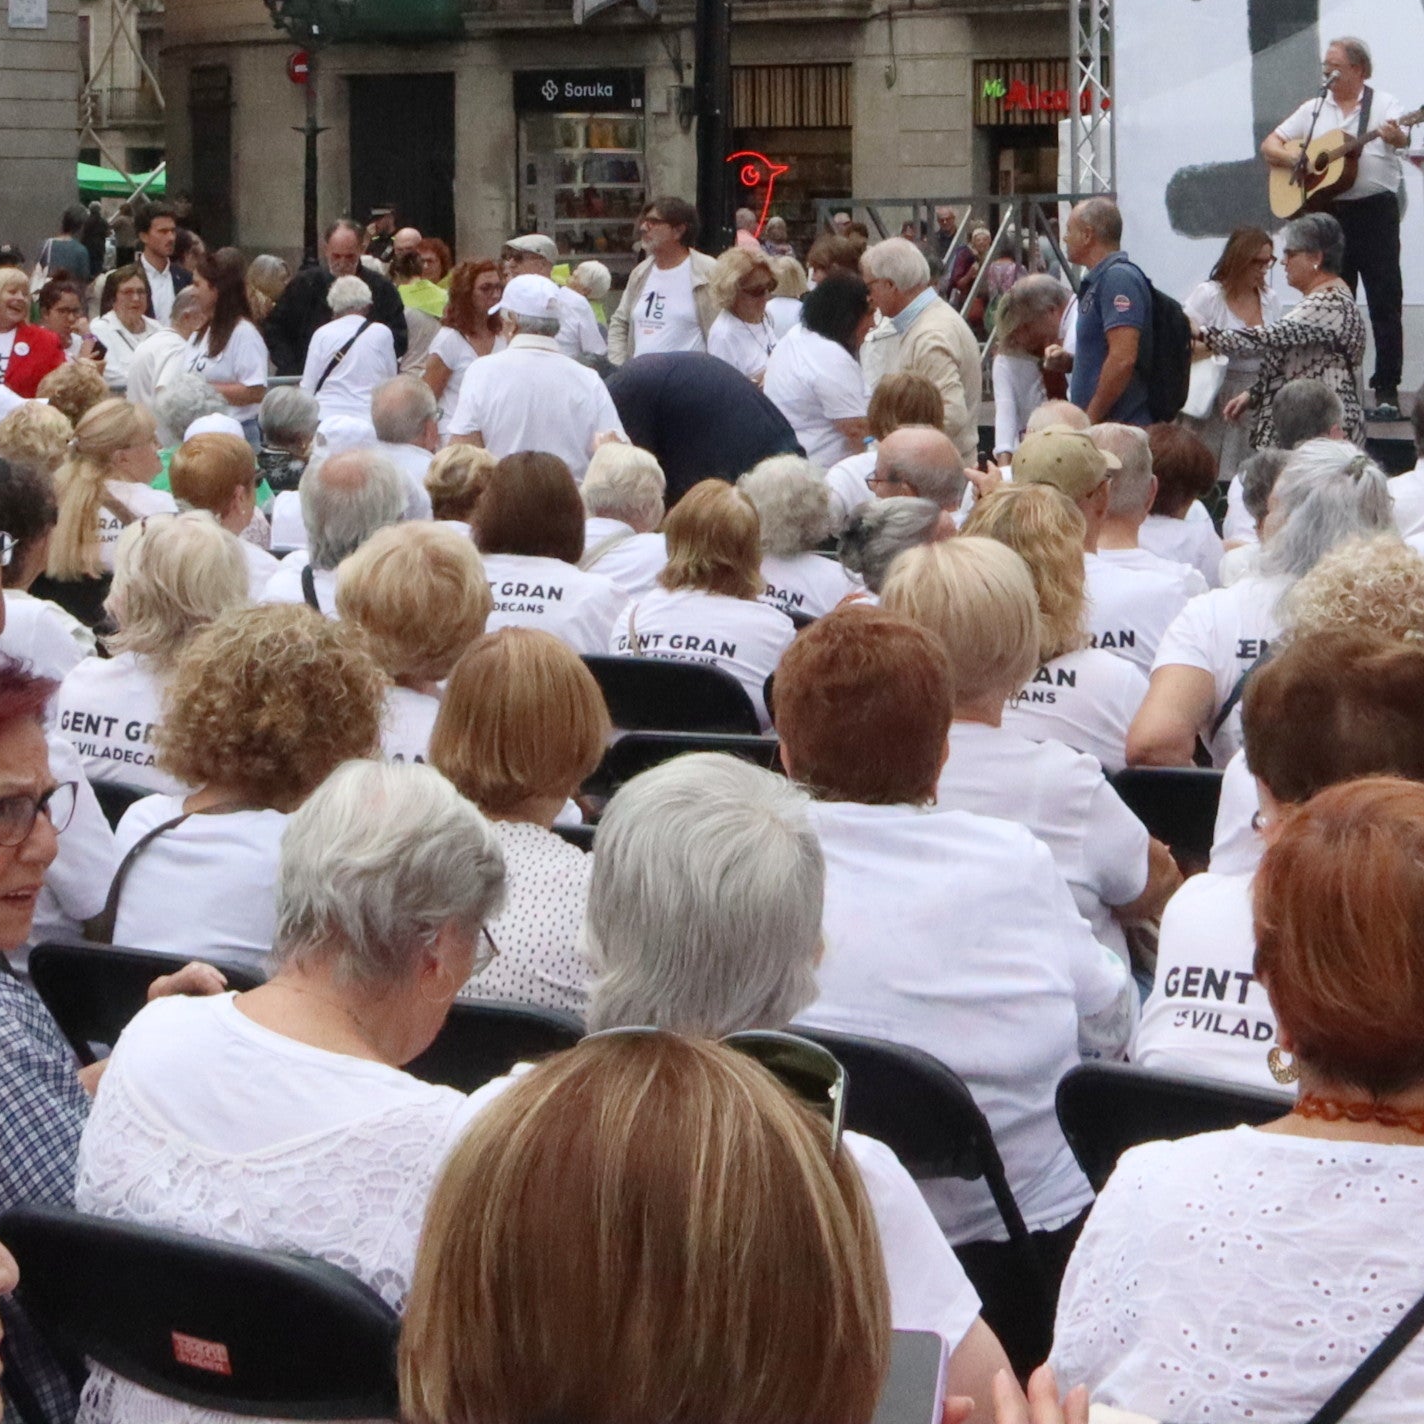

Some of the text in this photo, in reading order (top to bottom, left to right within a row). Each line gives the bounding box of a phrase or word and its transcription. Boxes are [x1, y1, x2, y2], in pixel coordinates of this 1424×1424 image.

[564, 82, 613, 97] Soruka
[645, 291, 655, 318] 1
[501, 582, 563, 601] GRAN
[766, 584, 804, 607] RAN
[493, 602, 544, 614] DECANS
[669, 634, 737, 659] GRAN
[1032, 666, 1076, 687] AN
[61, 710, 119, 738] GENT
[78, 742, 157, 769] VILADECA
[1164, 966, 1254, 1004] GENT
